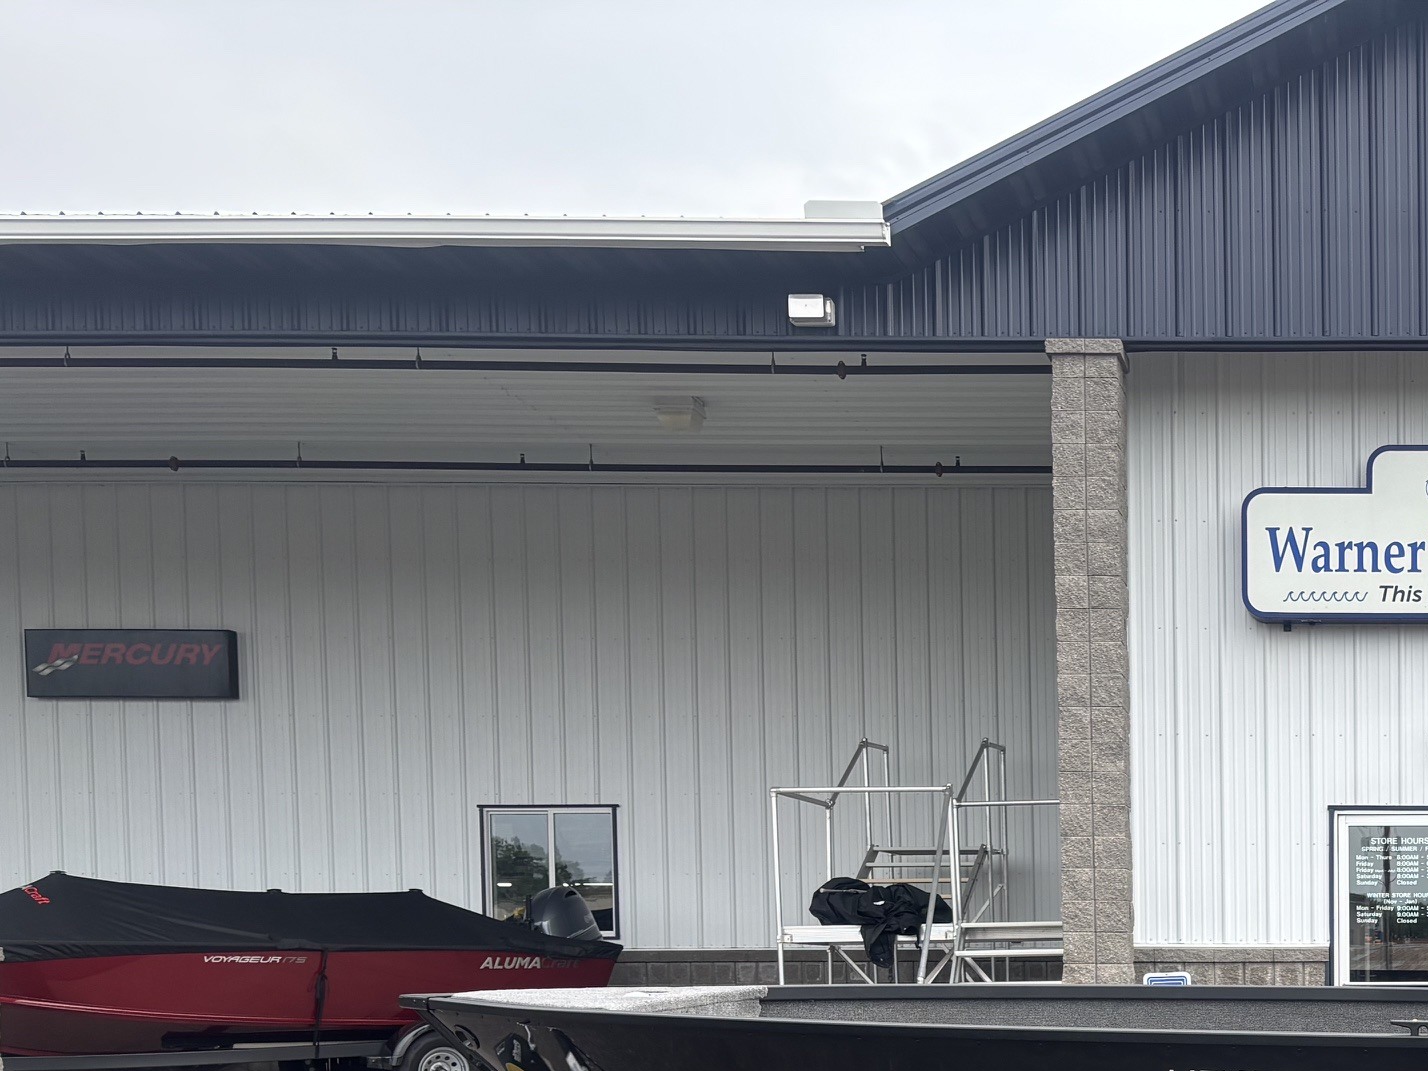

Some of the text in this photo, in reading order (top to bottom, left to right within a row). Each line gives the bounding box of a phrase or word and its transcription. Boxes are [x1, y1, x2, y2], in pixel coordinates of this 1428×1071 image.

[1378, 585, 1422, 603] This
[47, 642, 222, 666] MERCURY
[1370, 837, 1398, 845] STORE
[203, 955, 282, 964] VOYAGEUR
